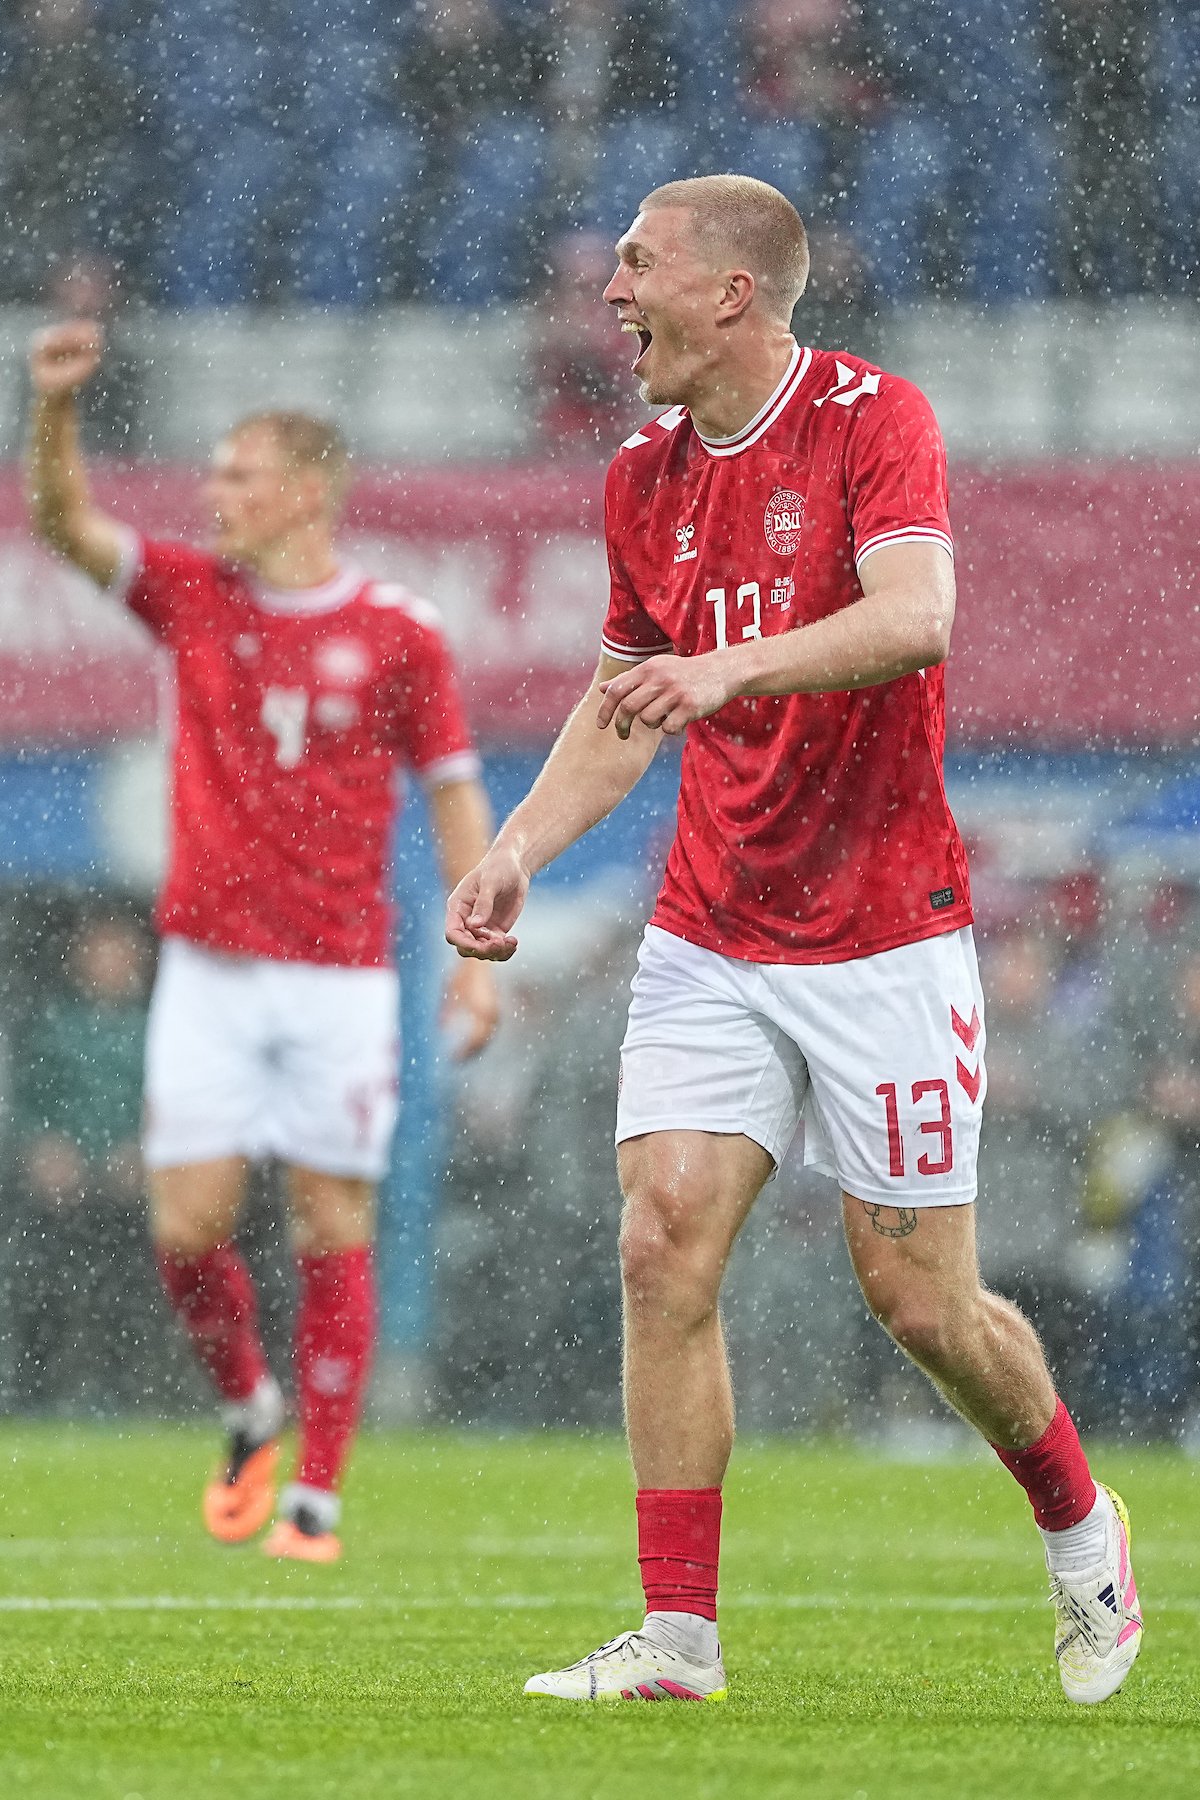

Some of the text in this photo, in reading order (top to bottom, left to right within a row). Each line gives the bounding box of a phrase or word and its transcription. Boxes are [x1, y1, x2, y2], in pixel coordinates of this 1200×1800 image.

[773, 511, 802, 532] DBU
[705, 581, 763, 651] 13
[875, 1078, 953, 1177] 13
